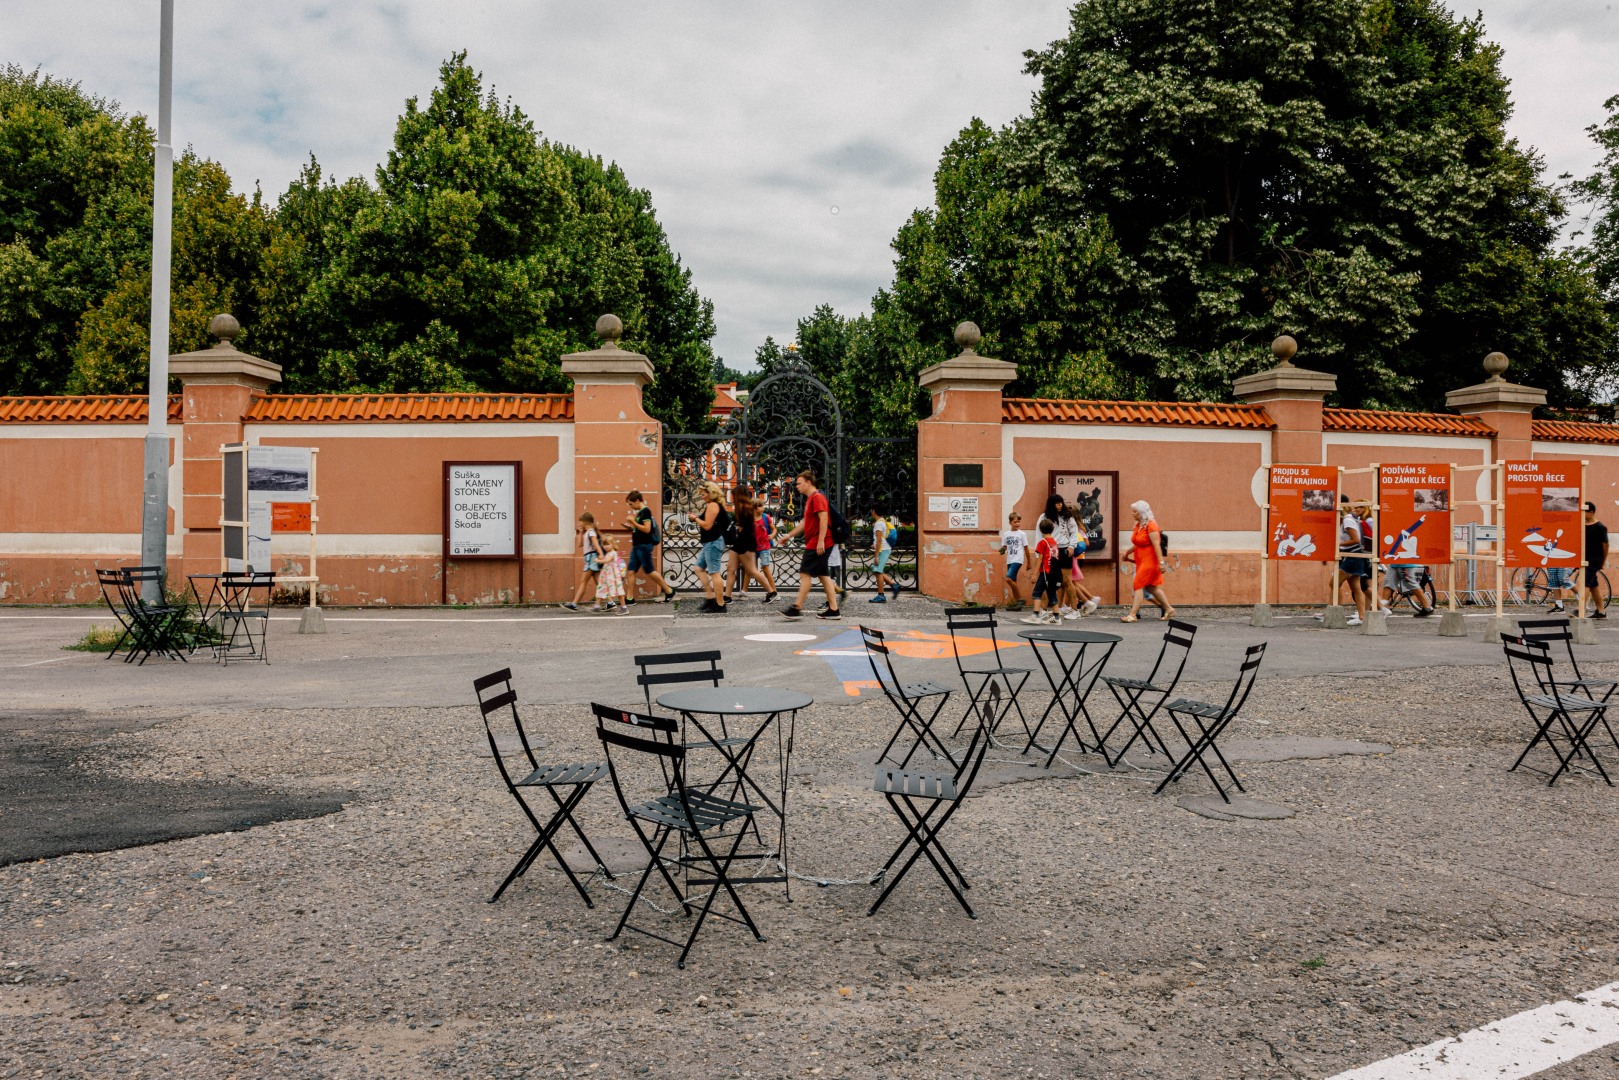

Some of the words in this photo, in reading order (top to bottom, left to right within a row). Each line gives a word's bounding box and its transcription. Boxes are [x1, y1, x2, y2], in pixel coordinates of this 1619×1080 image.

[1382, 466, 1416, 474] PODÍVÁM
[1508, 462, 1538, 472] VRACÍM
[454, 470, 480, 479] Suška
[1546, 472, 1565, 482] ŘECE
[1272, 475, 1292, 484] ŘÍČNÍ
[1394, 475, 1420, 484] ZÁMKU
[1428, 475, 1446, 484] ŘECE
[454, 518, 481, 528] Škoda
